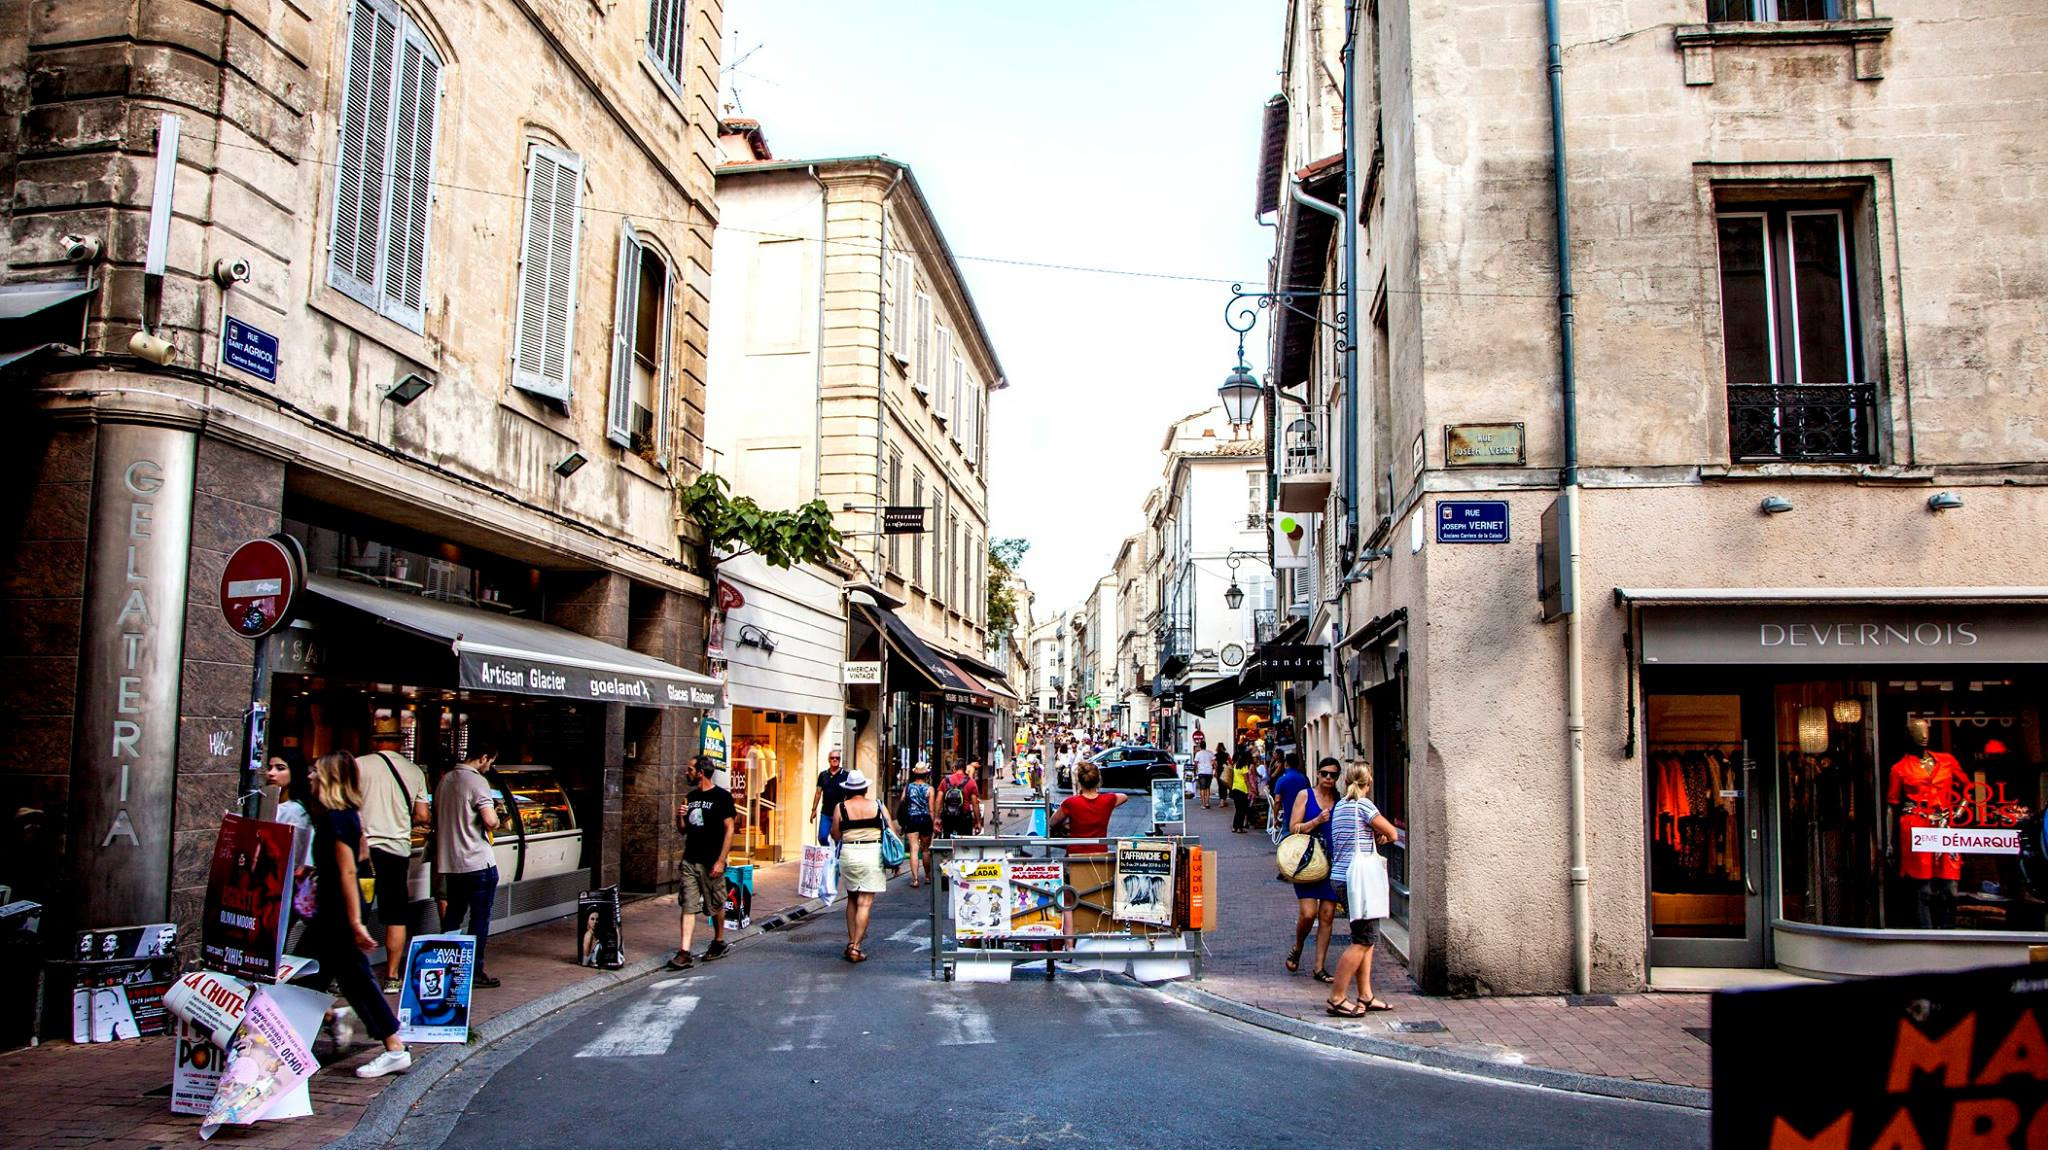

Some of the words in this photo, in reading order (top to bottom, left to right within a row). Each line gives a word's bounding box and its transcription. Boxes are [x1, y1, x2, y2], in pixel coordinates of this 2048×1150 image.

[247, 331, 259, 343] RUE
[228, 338, 244, 351] SAINT
[243, 343, 275, 365] AGRICOL
[1465, 509, 1480, 517] RUE
[1468, 521, 1504, 530] VERNET
[1760, 623, 1978, 646] DEVERNOIS
[102, 460, 165, 847] GELATERIA
[1262, 657, 1323, 666] sandro
[481, 662, 524, 687] Artisan
[530, 668, 566, 691] Glacier
[590, 677, 641, 698] goeland
[667, 684, 689, 701] Glaces
[690, 686, 715, 705] Maisons
[1942, 833, 2020, 848] DÉMARQUE
[1120, 850, 1162, 861] L'AFFRANCHIE
[219, 910, 238, 927] OLIVIA
[236, 914, 256, 931] MOORE
[433, 947, 472, 958] L'AVALÉE
[182, 972, 201, 990] LA
[200, 978, 245, 1019] CHUTE
[280, 1047, 305, 1076] 10H30
